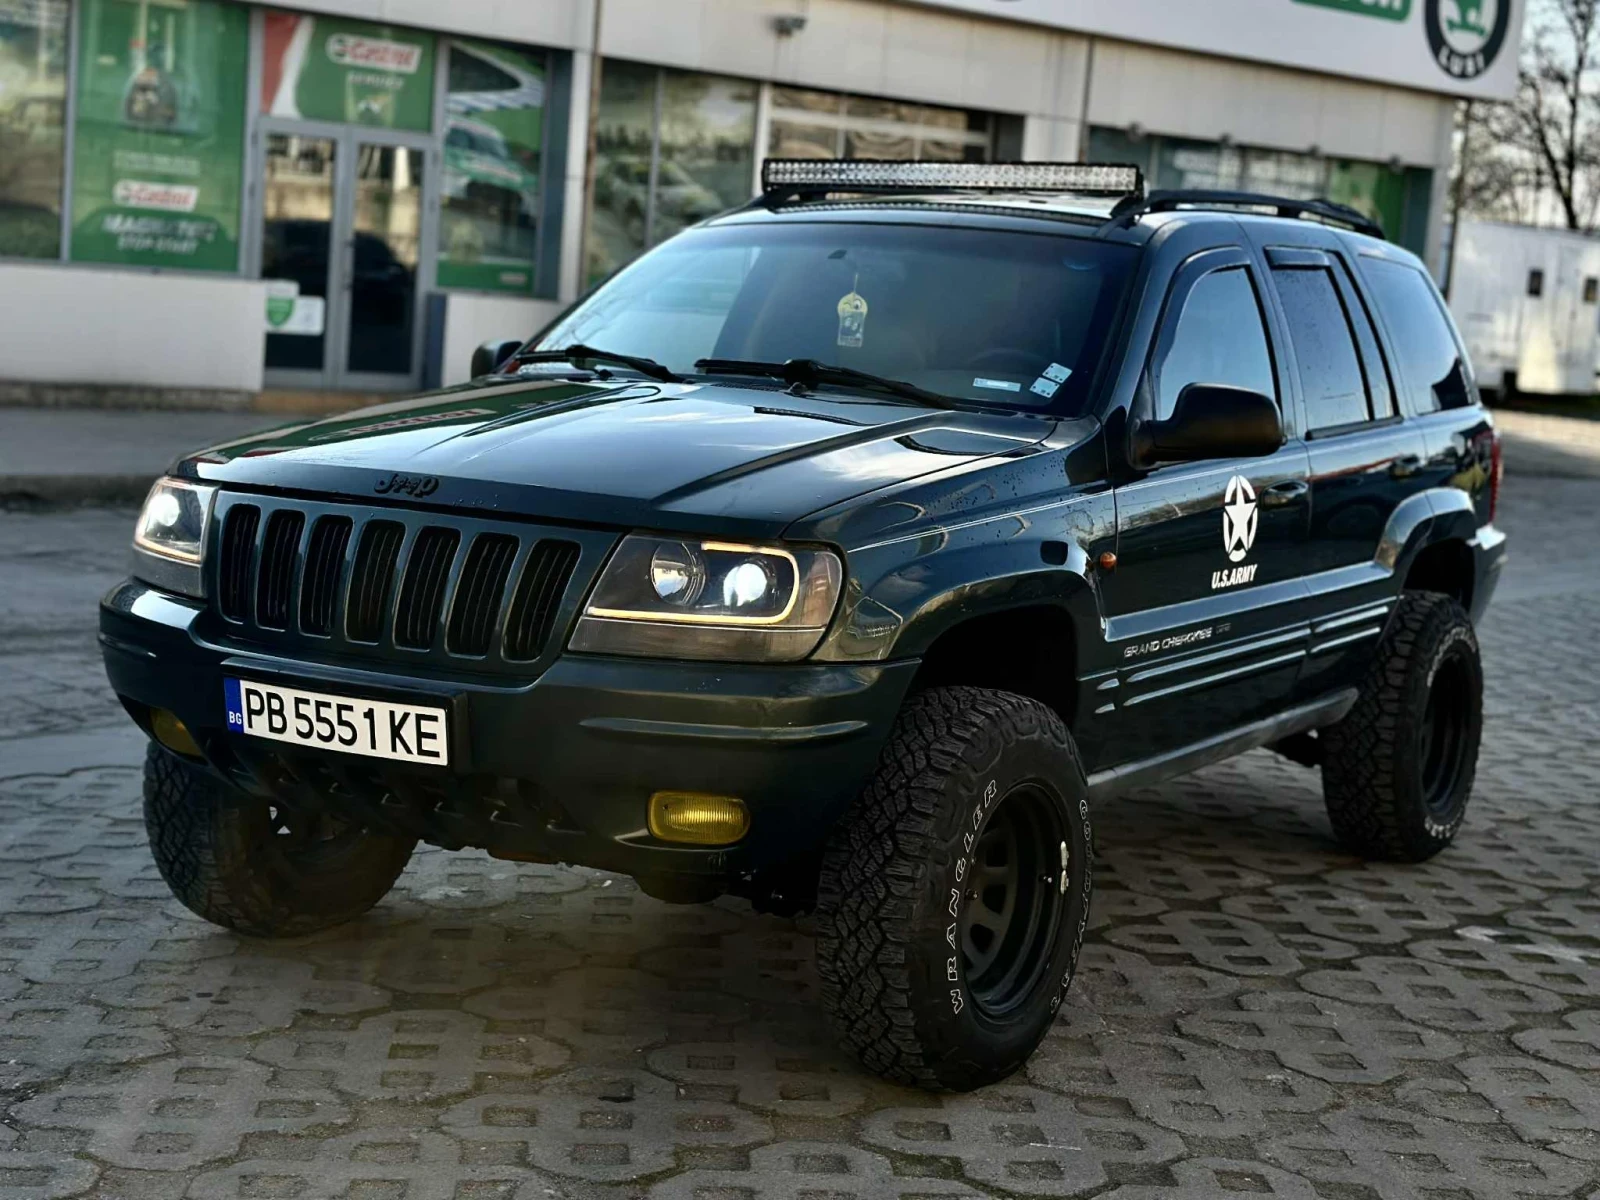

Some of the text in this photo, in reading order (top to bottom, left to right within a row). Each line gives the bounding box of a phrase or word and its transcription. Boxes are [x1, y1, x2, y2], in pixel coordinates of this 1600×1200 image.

[374, 473, 439, 498] Jeep
[1124, 640, 1160, 658] GRAND
[1161, 627, 1213, 649] CHEROKEE
[230, 711, 242, 725] BG
[245, 688, 441, 758] PB 5551 KE
[947, 780, 997, 1014] WRANGLER
